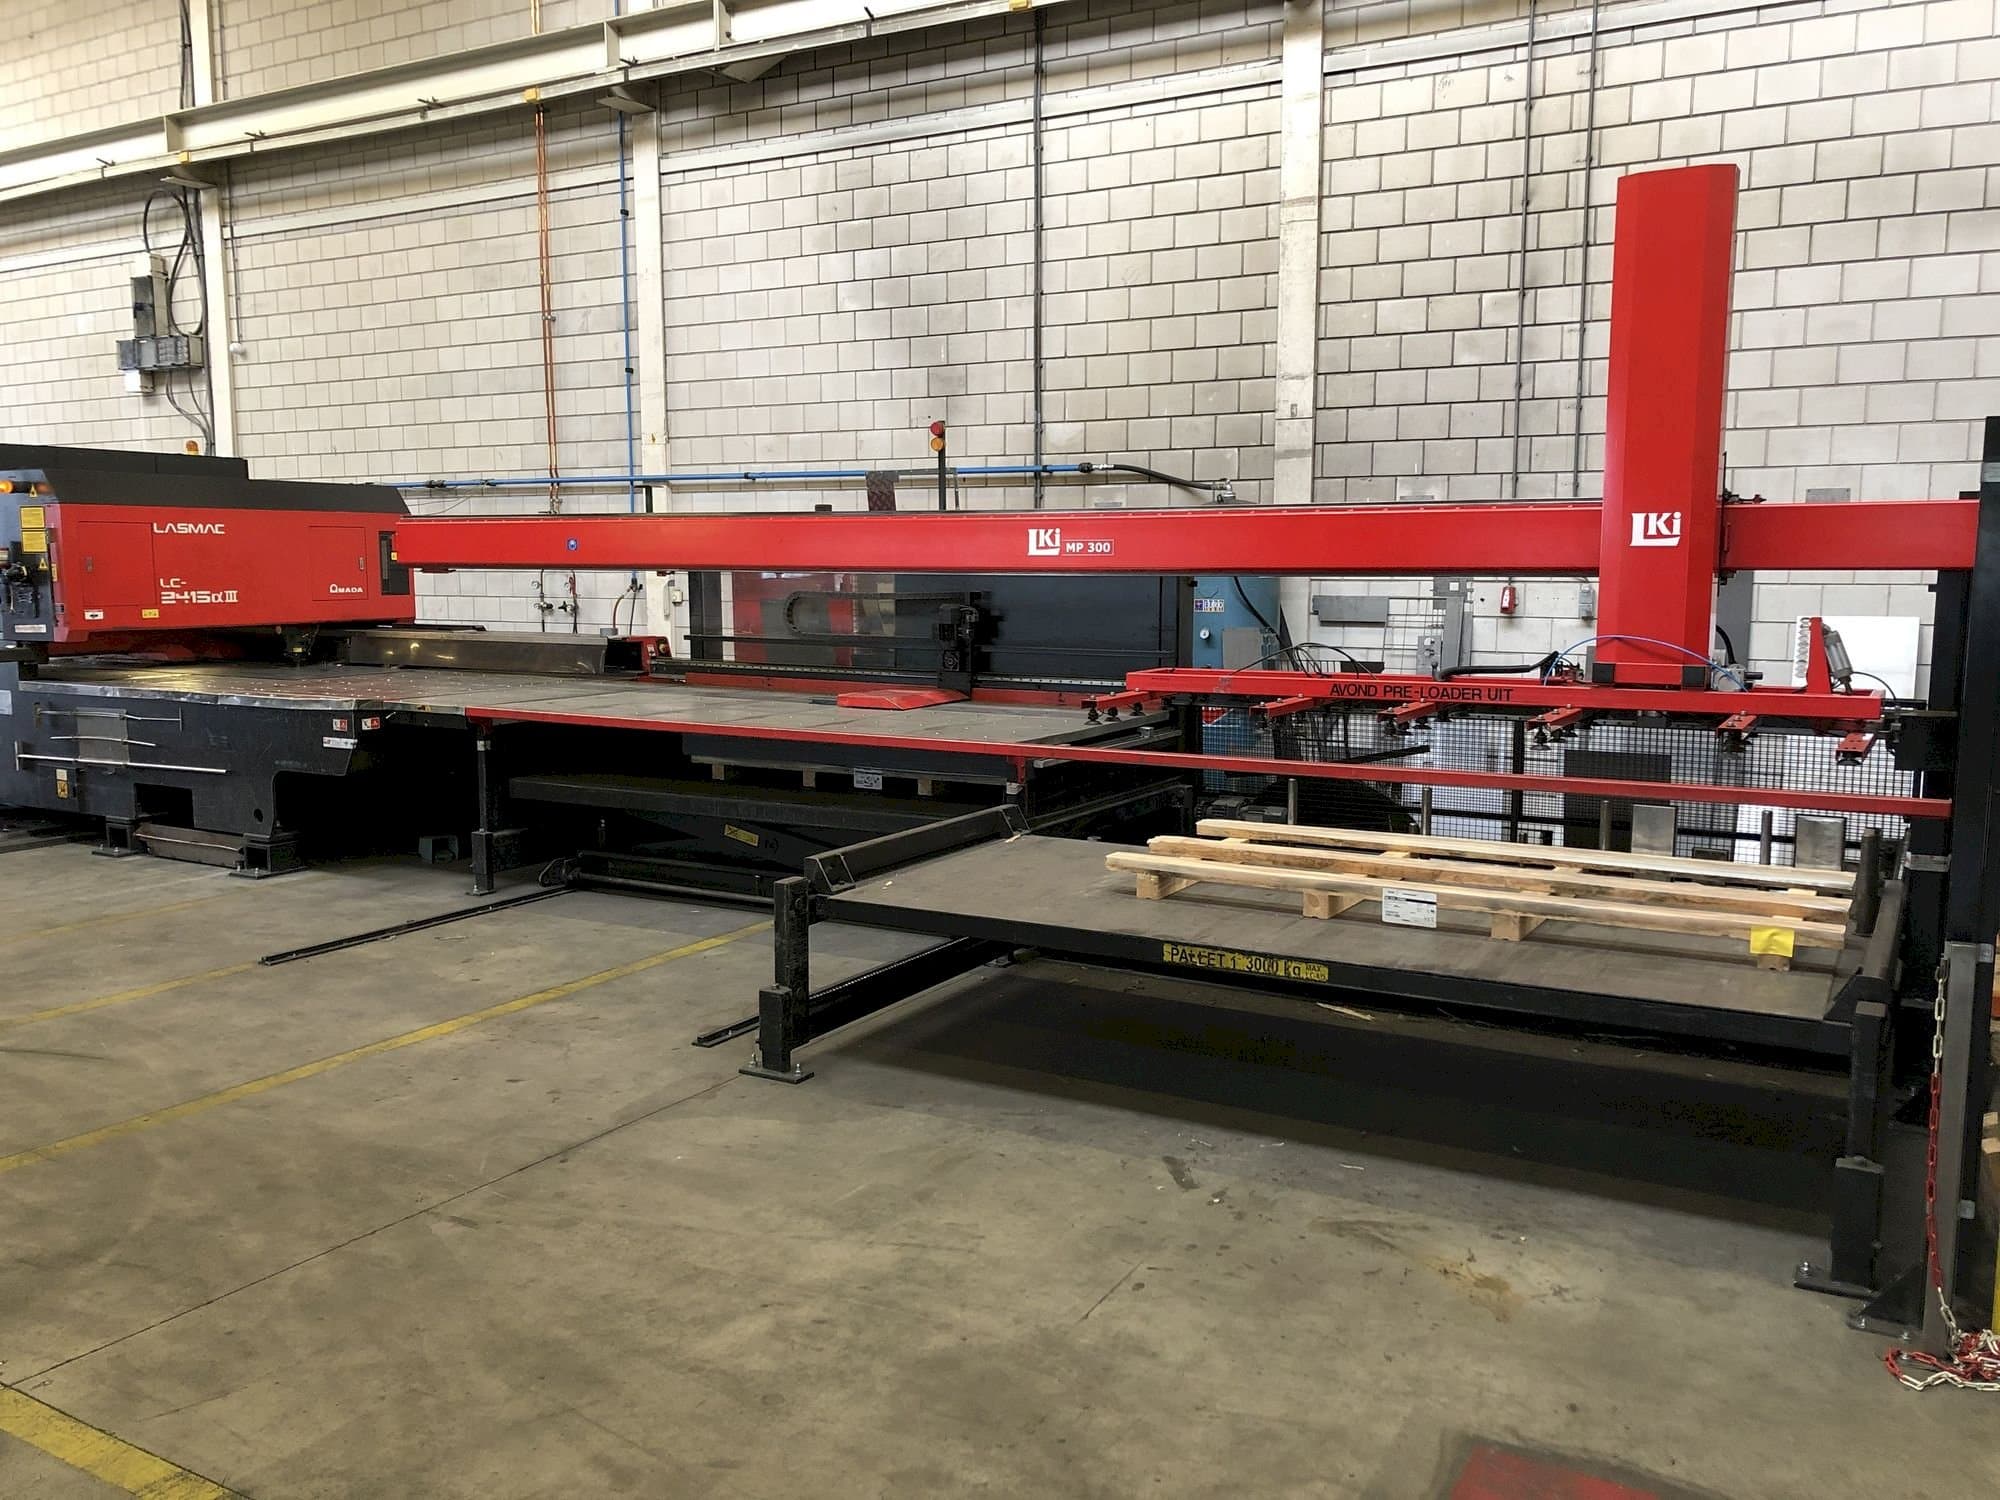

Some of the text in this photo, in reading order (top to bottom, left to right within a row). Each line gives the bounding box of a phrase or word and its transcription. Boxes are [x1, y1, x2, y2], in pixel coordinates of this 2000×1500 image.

[153, 522, 225, 535] LASMAC
[1066, 542, 1111, 553] MP 300
[160, 578, 187, 589] LC-
[1329, 683, 1514, 702] AVOND PRE-LOADER UIT
[1245, 956, 1279, 973] 3000
